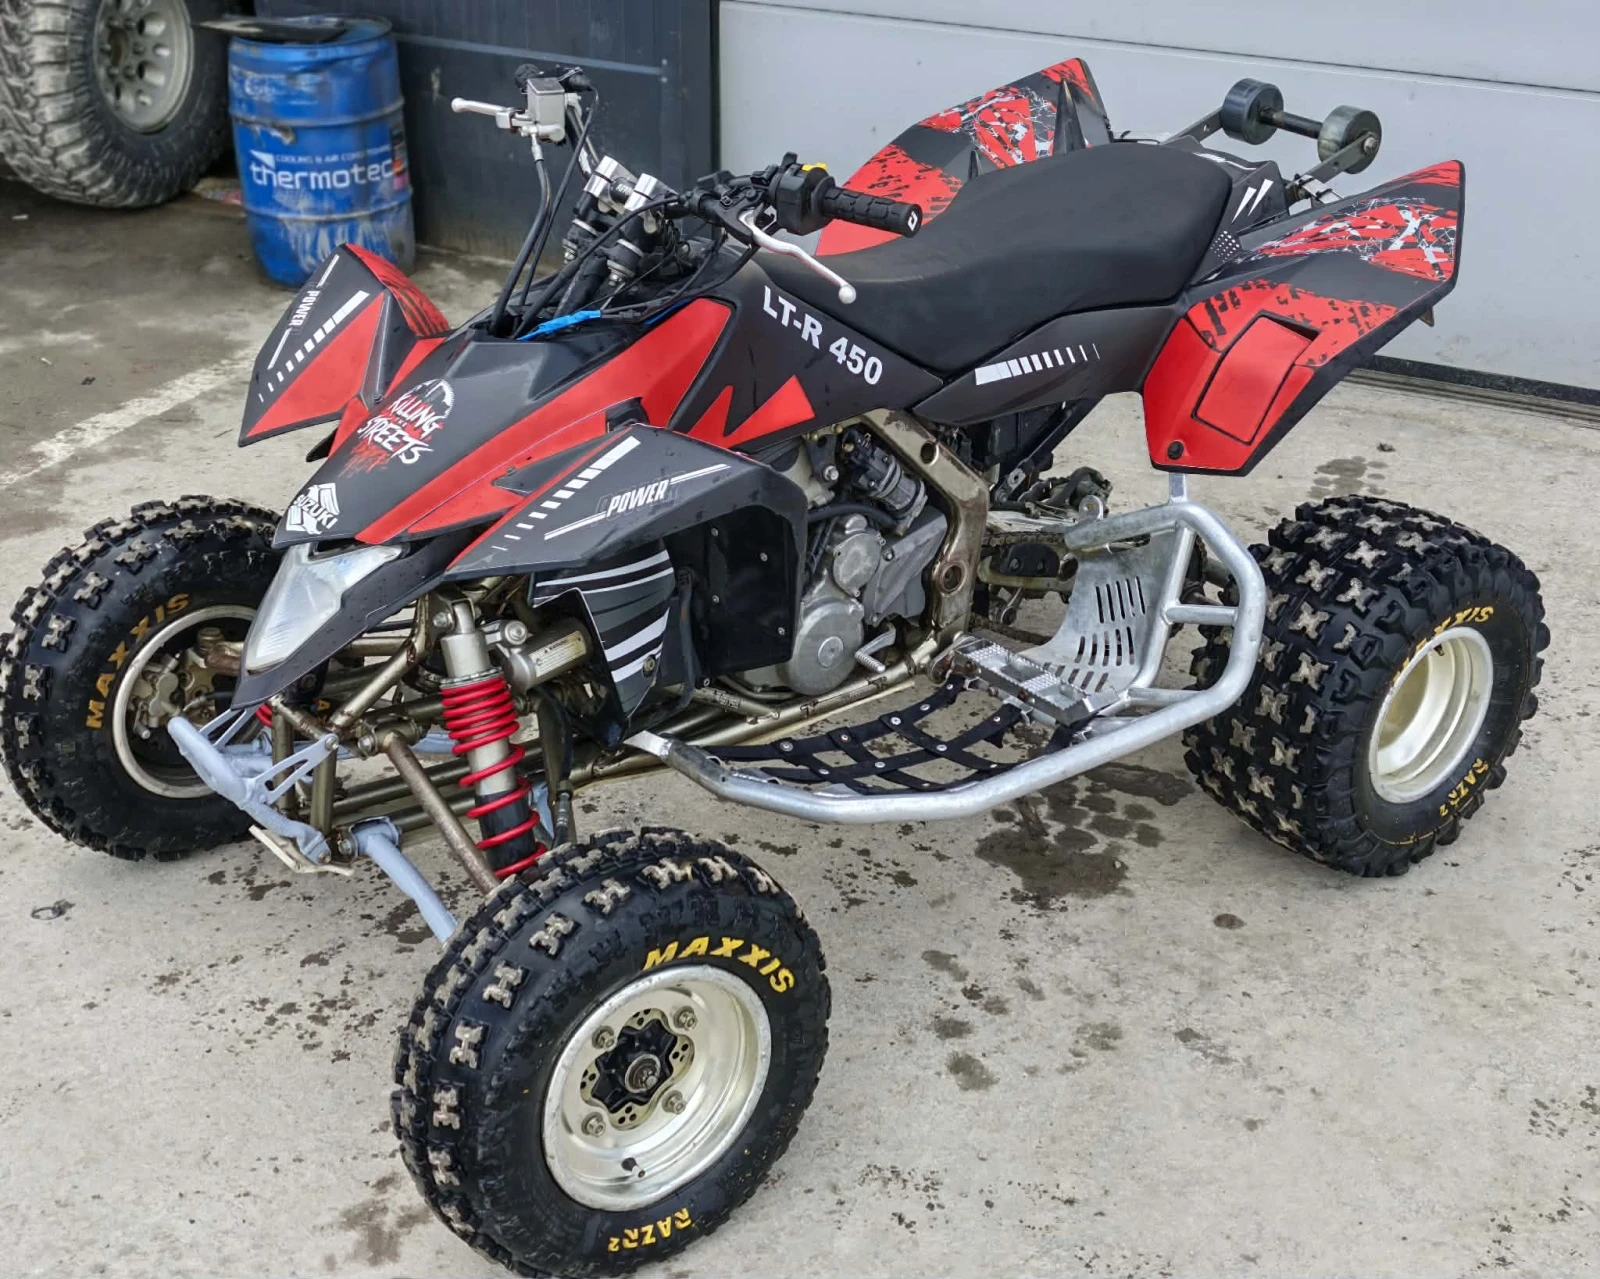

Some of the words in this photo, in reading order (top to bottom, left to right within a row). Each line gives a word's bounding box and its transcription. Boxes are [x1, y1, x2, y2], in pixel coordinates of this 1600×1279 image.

[250, 159, 394, 190] thermotec
[289, 290, 321, 326] POWER
[763, 285, 823, 350] LT-R
[829, 336, 883, 385] 450
[356, 414, 435, 465] STREETS
[387, 391, 440, 440] KILLING
[293, 494, 339, 530] SUZUKI
[606, 479, 670, 518] POWER
[86, 593, 190, 729] MAXXIS
[642, 936, 795, 993] MAXXIS
